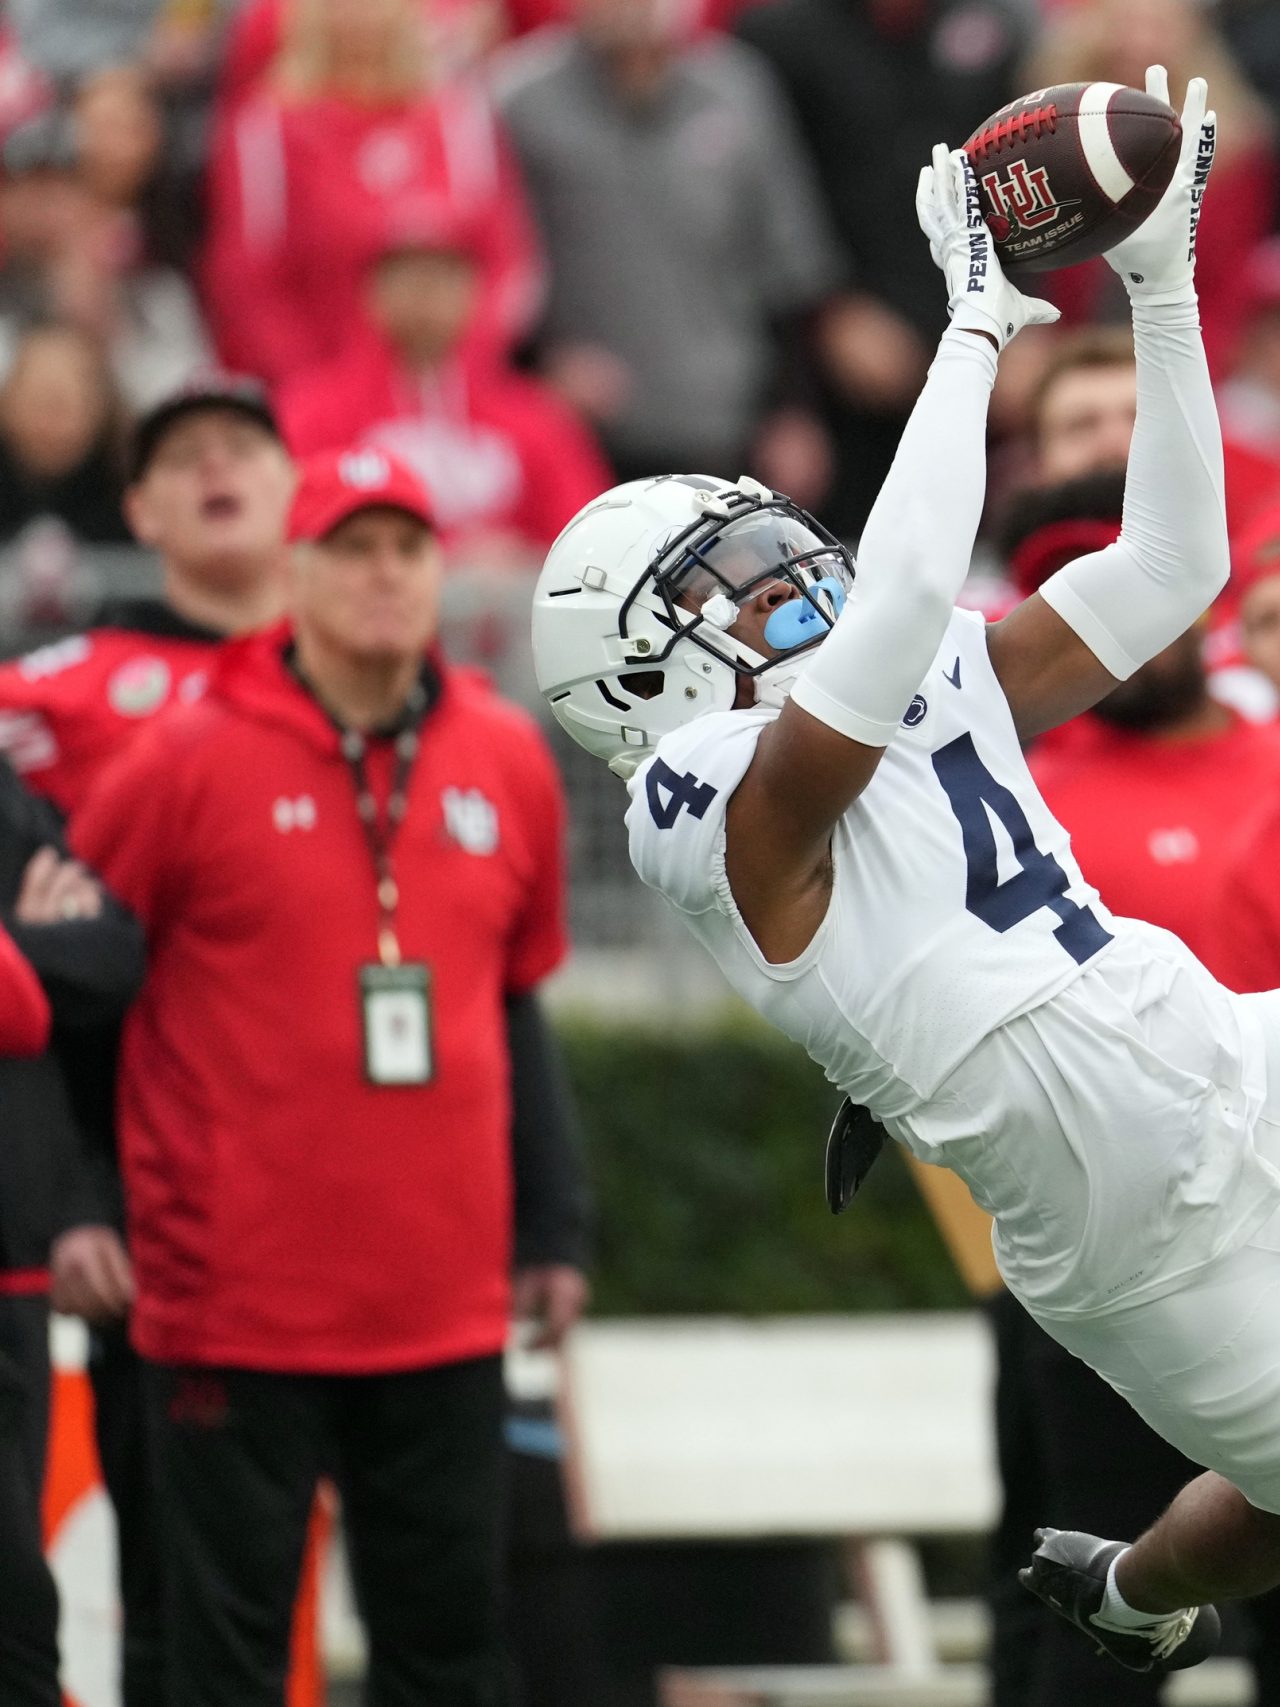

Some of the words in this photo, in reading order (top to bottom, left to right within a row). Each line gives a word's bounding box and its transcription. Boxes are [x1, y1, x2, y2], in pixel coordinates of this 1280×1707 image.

[1193, 124, 1215, 185] PENN
[1004, 234, 1043, 253] TEAM
[1044, 211, 1085, 240] ISSUE
[967, 233, 988, 293] PENN
[646, 757, 718, 829] 4
[930, 730, 1115, 966] 4
